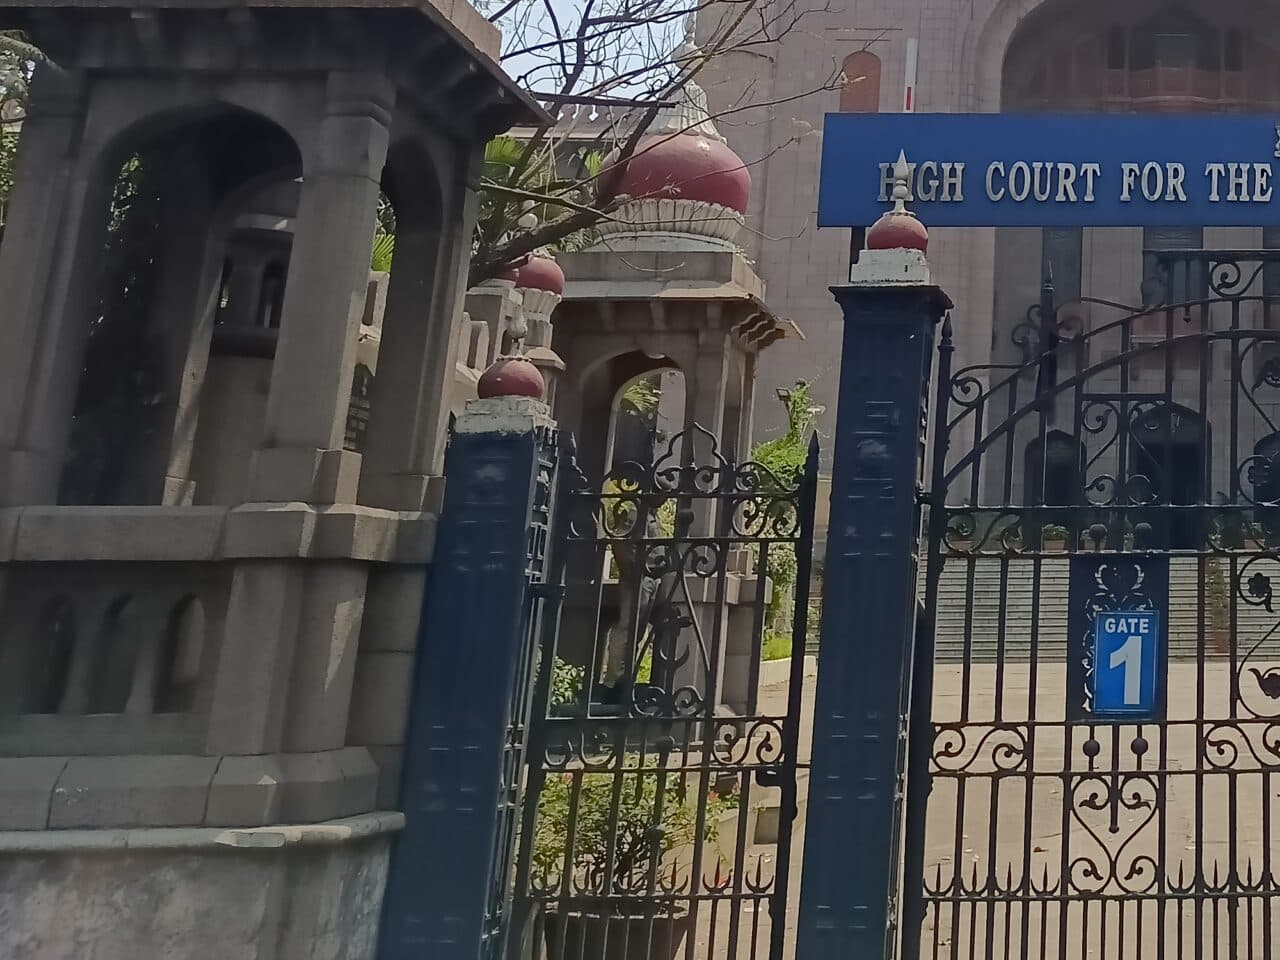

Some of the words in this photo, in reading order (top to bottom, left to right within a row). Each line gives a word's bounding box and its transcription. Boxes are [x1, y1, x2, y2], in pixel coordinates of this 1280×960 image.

[985, 161, 1101, 202] COURT
[1120, 161, 1187, 202] FOR
[1205, 162, 1273, 202] THE
[1104, 617, 1150, 634] GATE
[1109, 635, 1143, 705] 1
